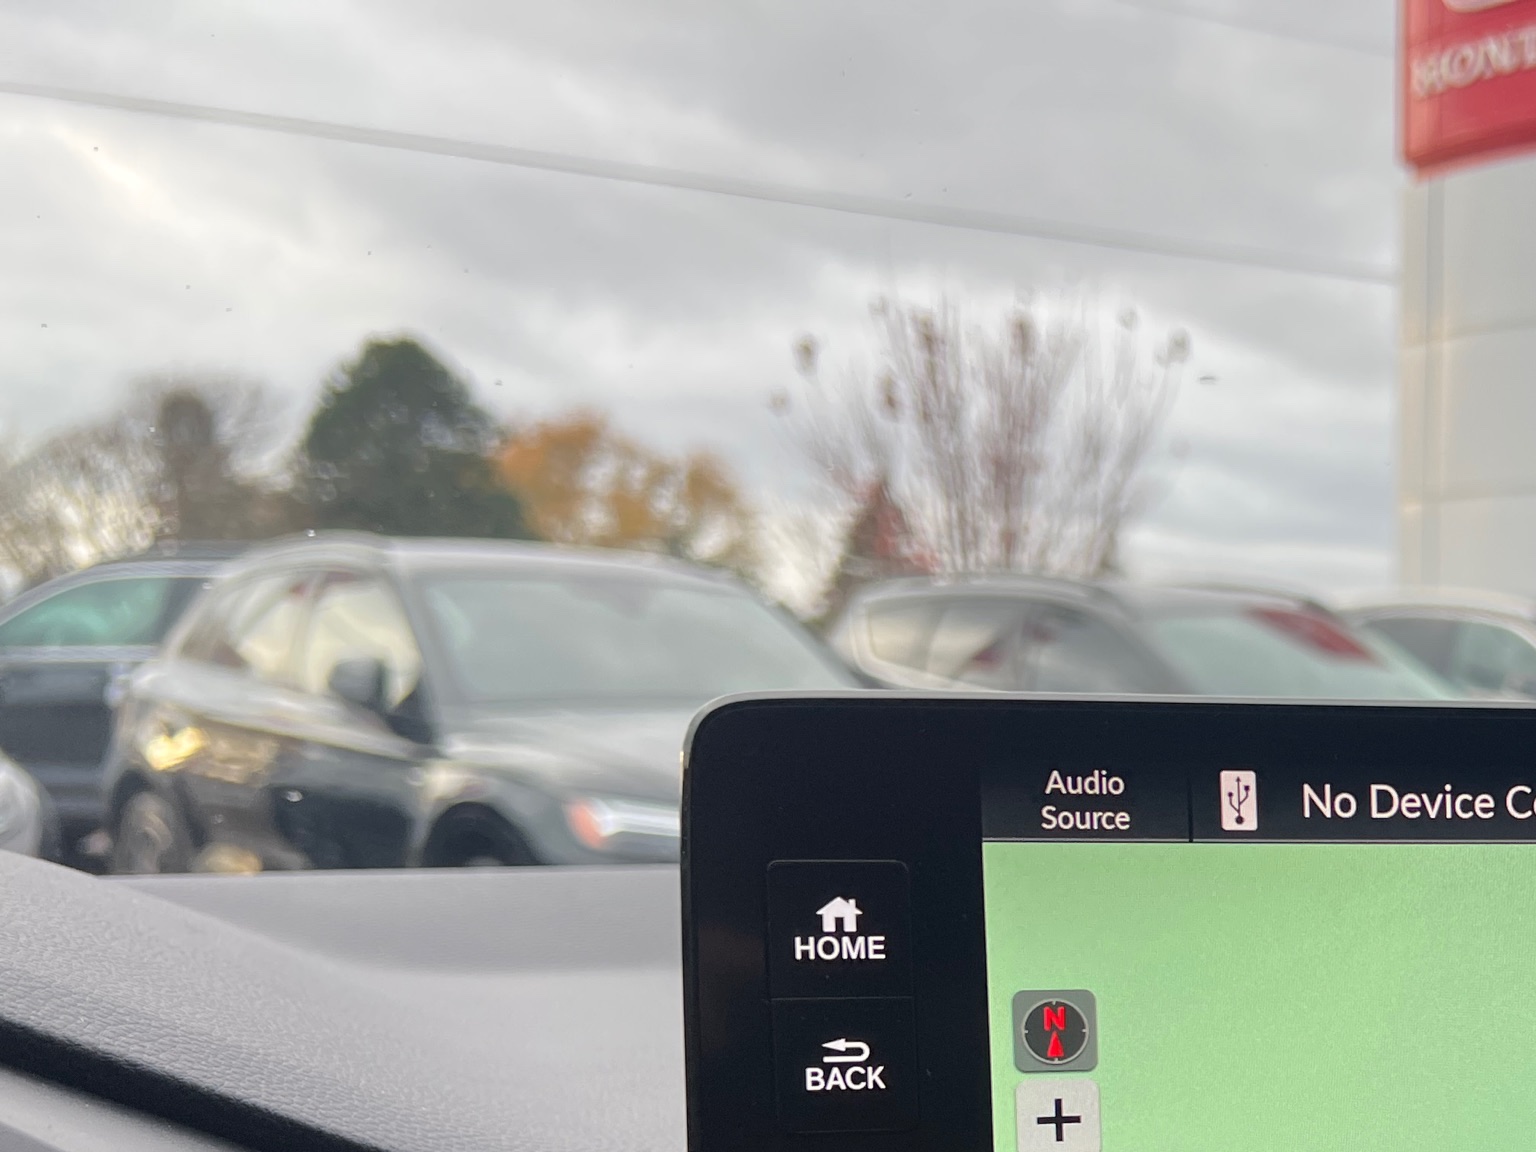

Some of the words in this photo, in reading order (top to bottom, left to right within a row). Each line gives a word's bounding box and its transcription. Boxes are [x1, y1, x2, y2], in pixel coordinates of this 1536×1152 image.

[1045, 769, 1125, 795] Audio
[1303, 783, 1357, 819] No
[1370, 783, 1495, 819] Device
[1041, 805, 1131, 830] Source
[794, 935, 886, 961] HOME
[1043, 1006, 1066, 1031] N
[805, 1065, 886, 1091] BACK
